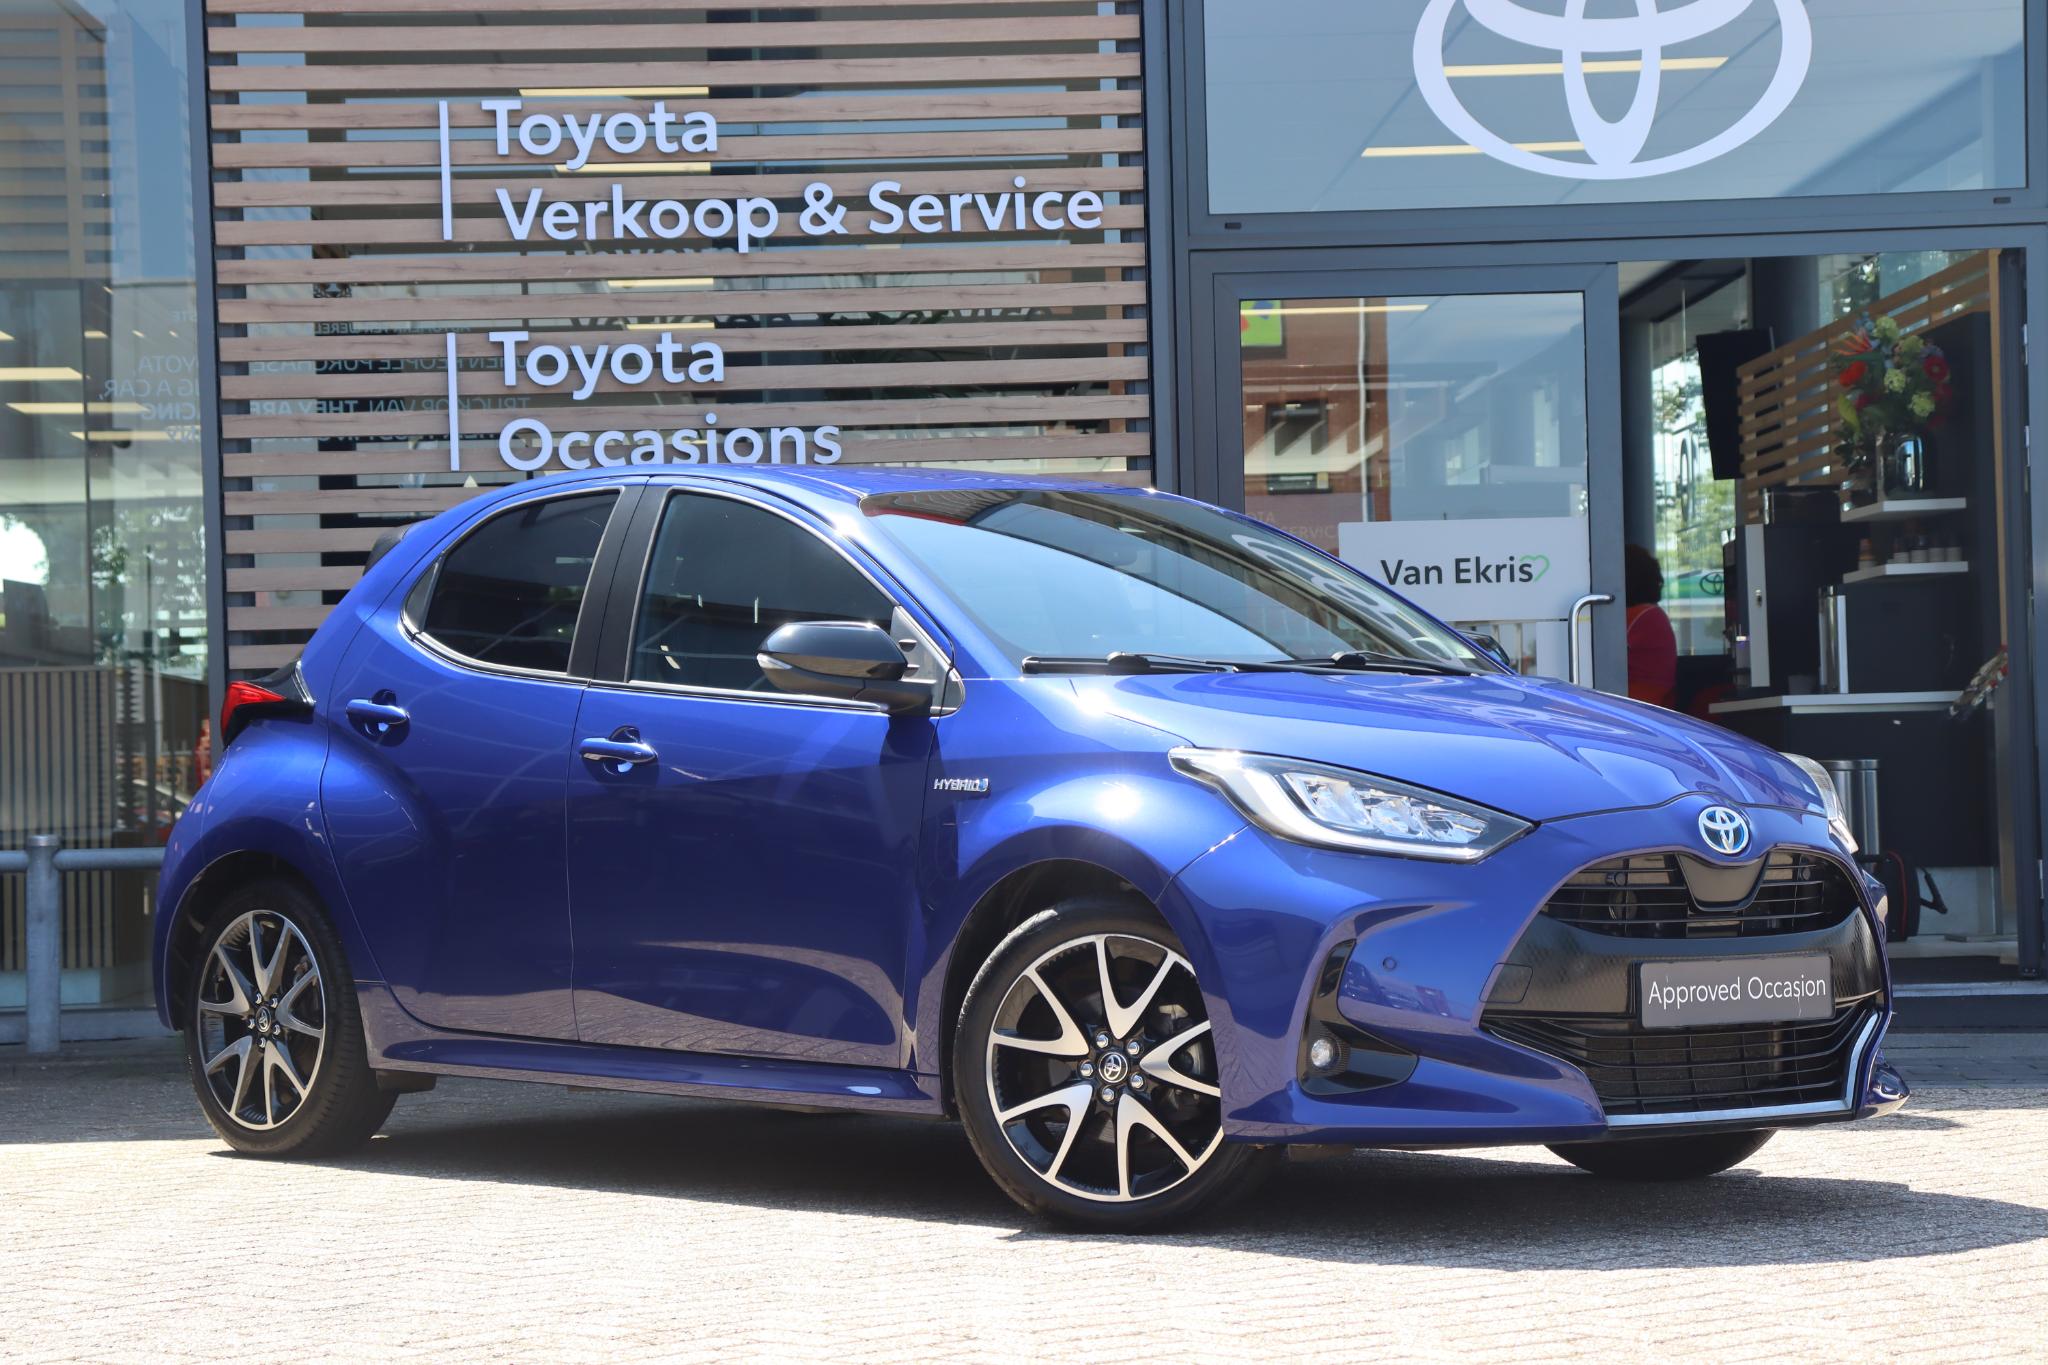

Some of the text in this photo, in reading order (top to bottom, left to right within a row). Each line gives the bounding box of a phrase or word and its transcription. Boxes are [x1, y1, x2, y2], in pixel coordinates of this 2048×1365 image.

[481, 99, 719, 171] Toyota
[496, 176, 1105, 254] Verkoop & Service
[488, 330, 726, 401] Toyota
[498, 412, 843, 472] Occasions
[1380, 556, 1534, 586] Van Ekris
[933, 778, 983, 792] HYBRID
[1648, 974, 1826, 1010] Approved Occasion
